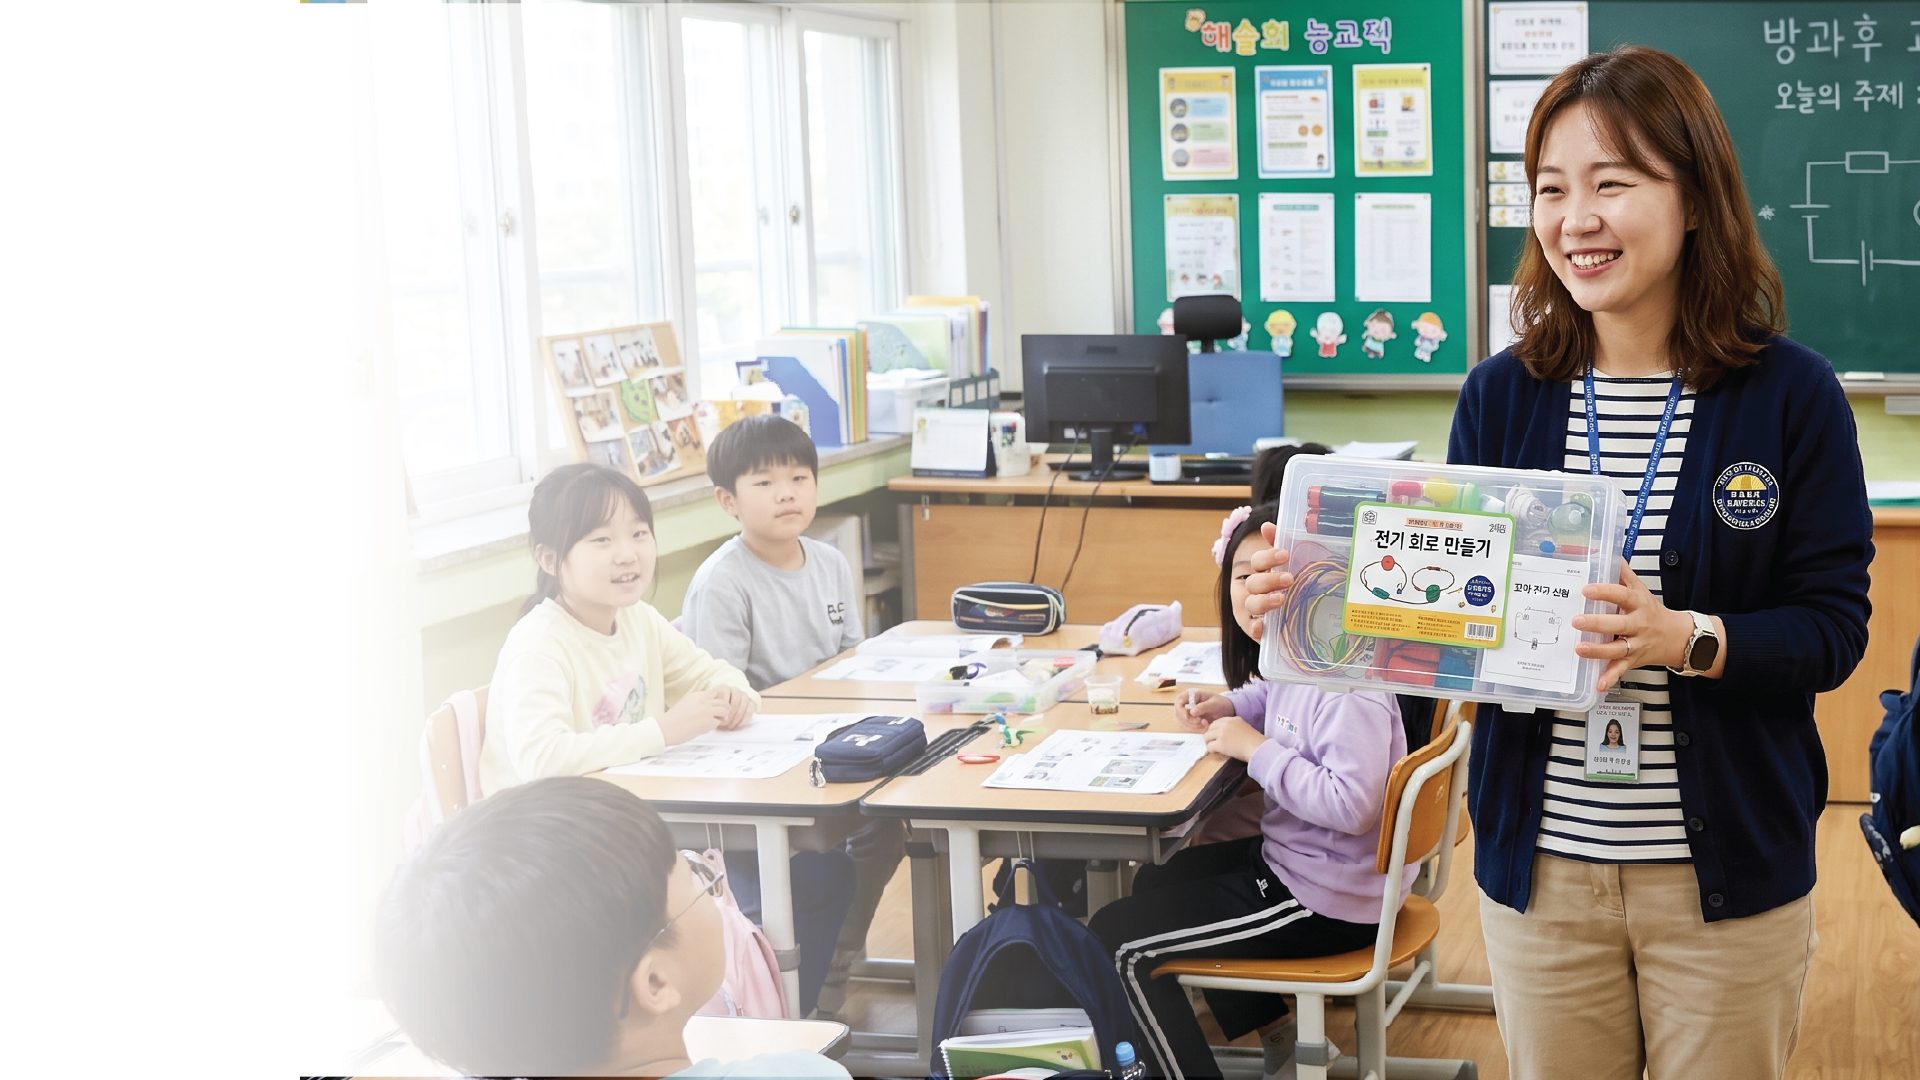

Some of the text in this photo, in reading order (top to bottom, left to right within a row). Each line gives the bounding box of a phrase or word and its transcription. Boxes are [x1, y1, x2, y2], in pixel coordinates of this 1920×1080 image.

[1763, 13, 1882, 65] 방과후
[1774, 80, 1841, 114] 오늘의
[1853, 80, 1903, 112] 주제
[1374, 529, 1491, 559] 전기 회로 만들기
